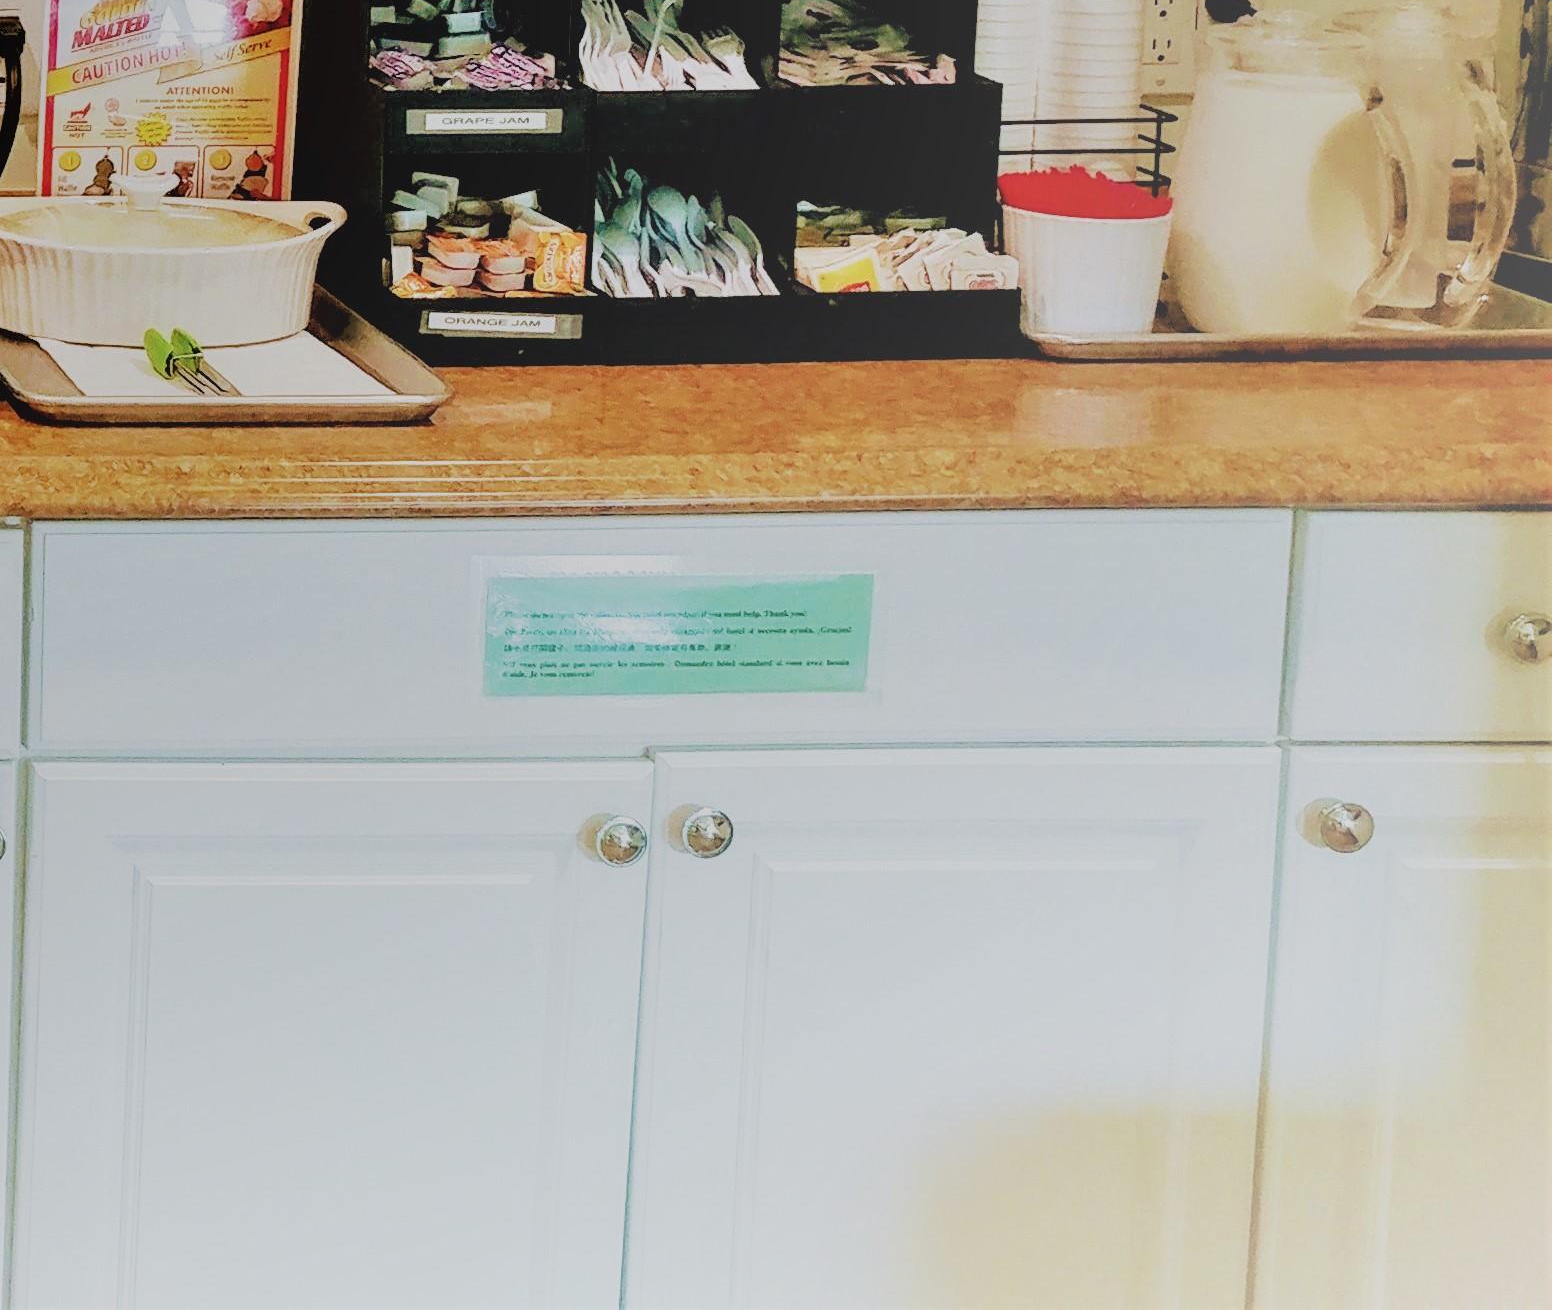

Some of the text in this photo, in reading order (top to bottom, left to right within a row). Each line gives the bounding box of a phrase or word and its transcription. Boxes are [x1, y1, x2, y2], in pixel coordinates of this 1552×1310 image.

[71, 12, 151, 49] MALTED
[237, 37, 273, 56] Serve
[71, 51, 145, 85] CAUTION
[166, 84, 235, 96] ATTENTION!
[441, 117, 495, 126] GRAPE
[444, 316, 542, 327] ORANGE JAM
